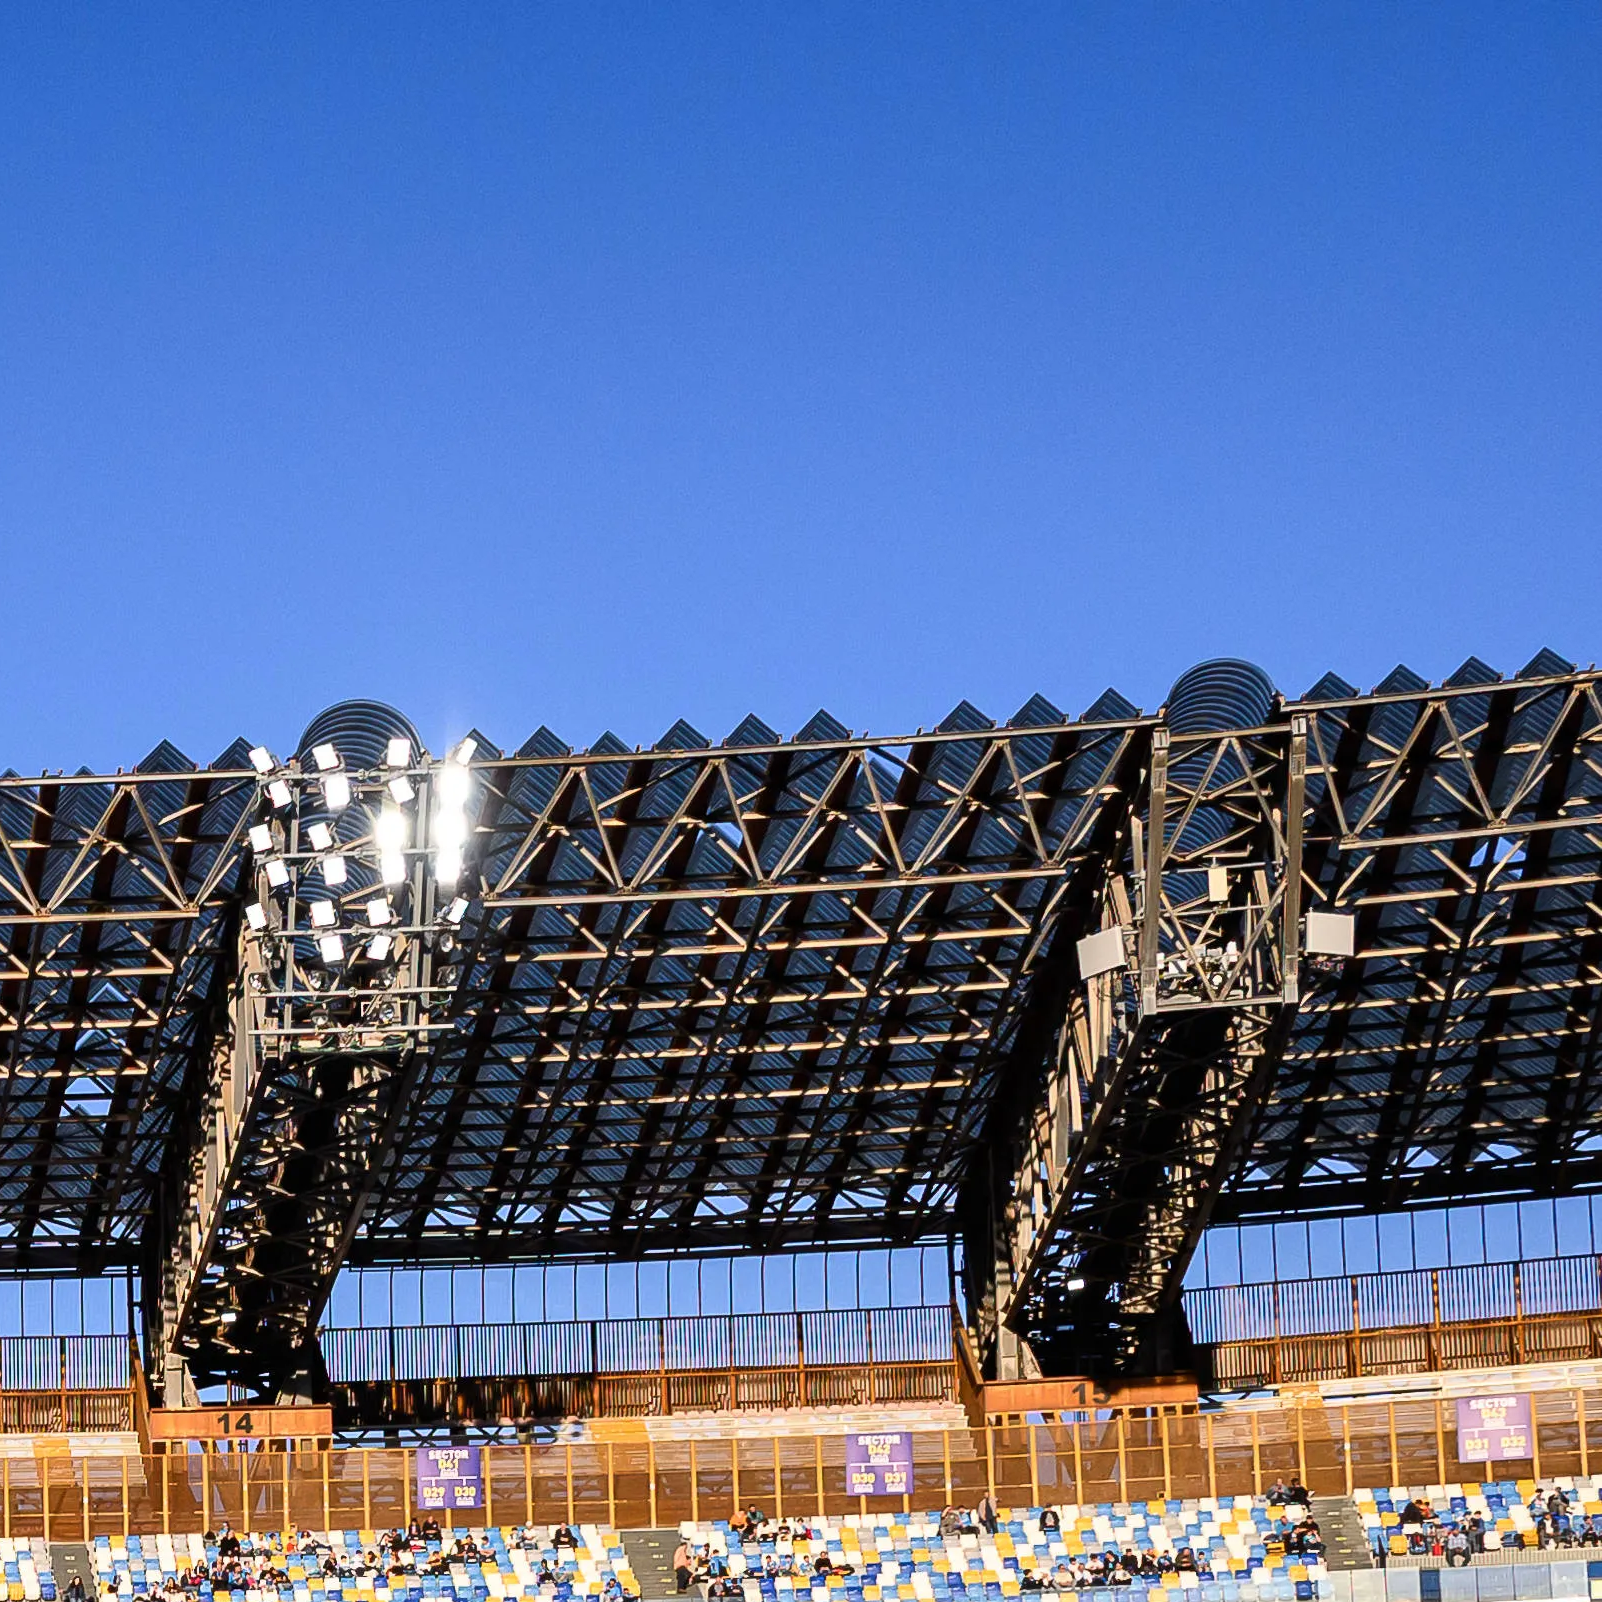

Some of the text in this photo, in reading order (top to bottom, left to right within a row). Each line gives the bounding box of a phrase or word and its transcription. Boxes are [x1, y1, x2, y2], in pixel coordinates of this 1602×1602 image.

[1469, 1397, 1517, 1410] SECTOR
[217, 1413, 253, 1434] 14
[857, 1434, 901, 1446] SECTOR
[428, 1449, 469, 1460] SECTOR
